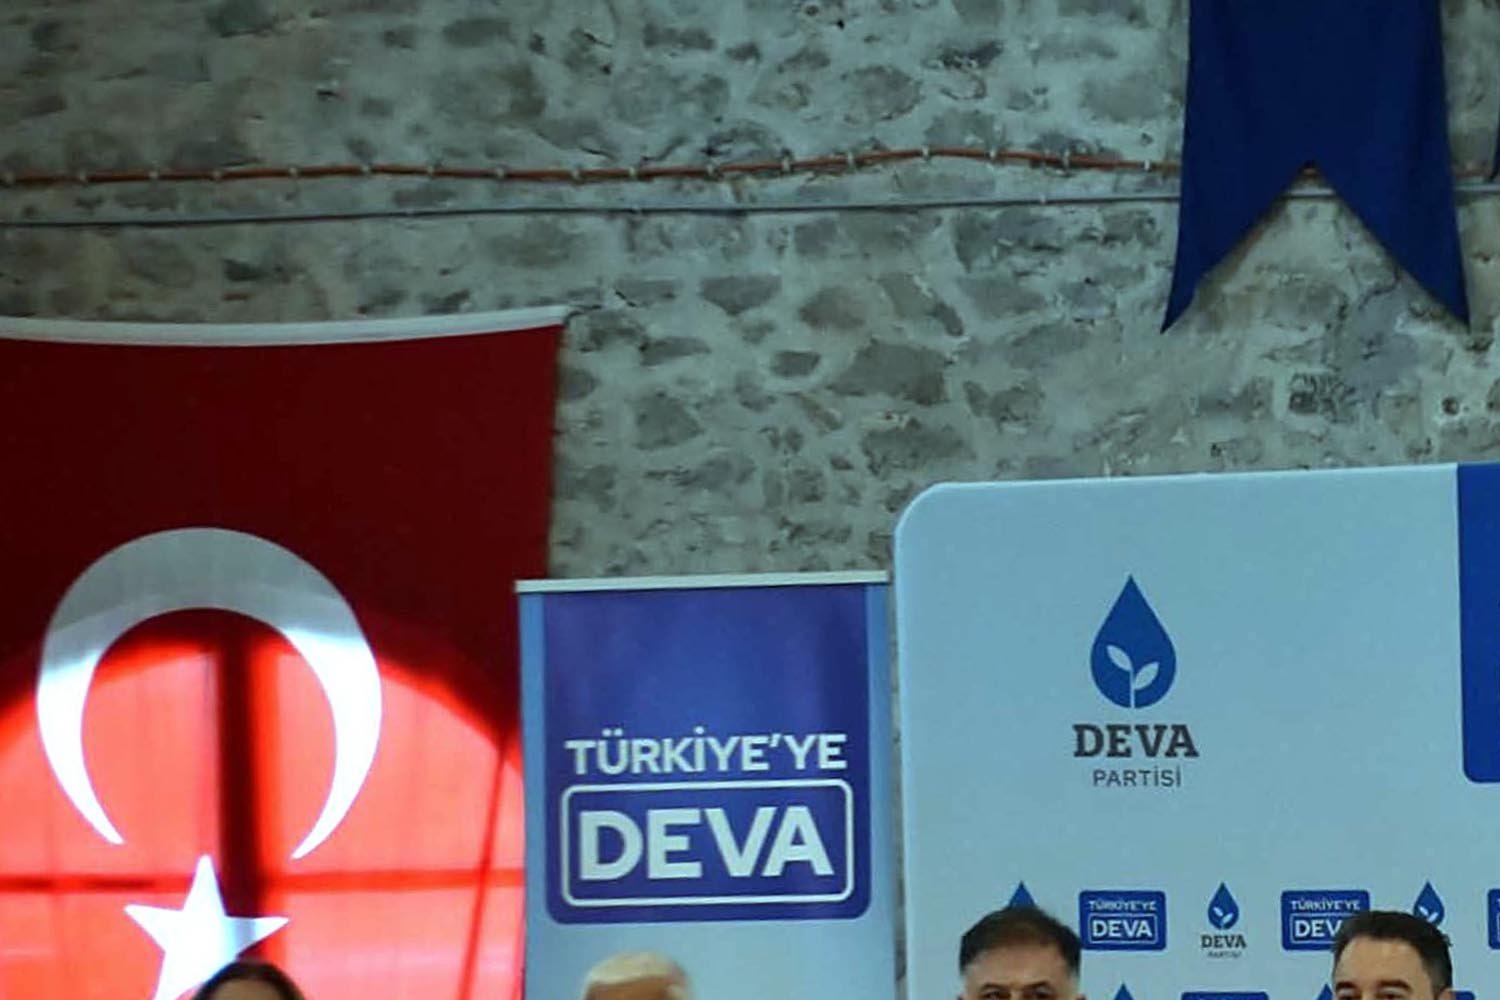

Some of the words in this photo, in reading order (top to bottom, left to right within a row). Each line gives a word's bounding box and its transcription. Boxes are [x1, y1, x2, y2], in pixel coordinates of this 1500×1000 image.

[564, 725, 848, 775] TÜRKİYE'YE
[1072, 723, 1199, 758] DEVA
[1093, 765, 1183, 788] PARTİSİ
[579, 805, 835, 881] DEVA
[1092, 919, 1153, 938] DEVA
[1295, 919, 1343, 938] DEV
[1201, 935, 1247, 949] DEVA
